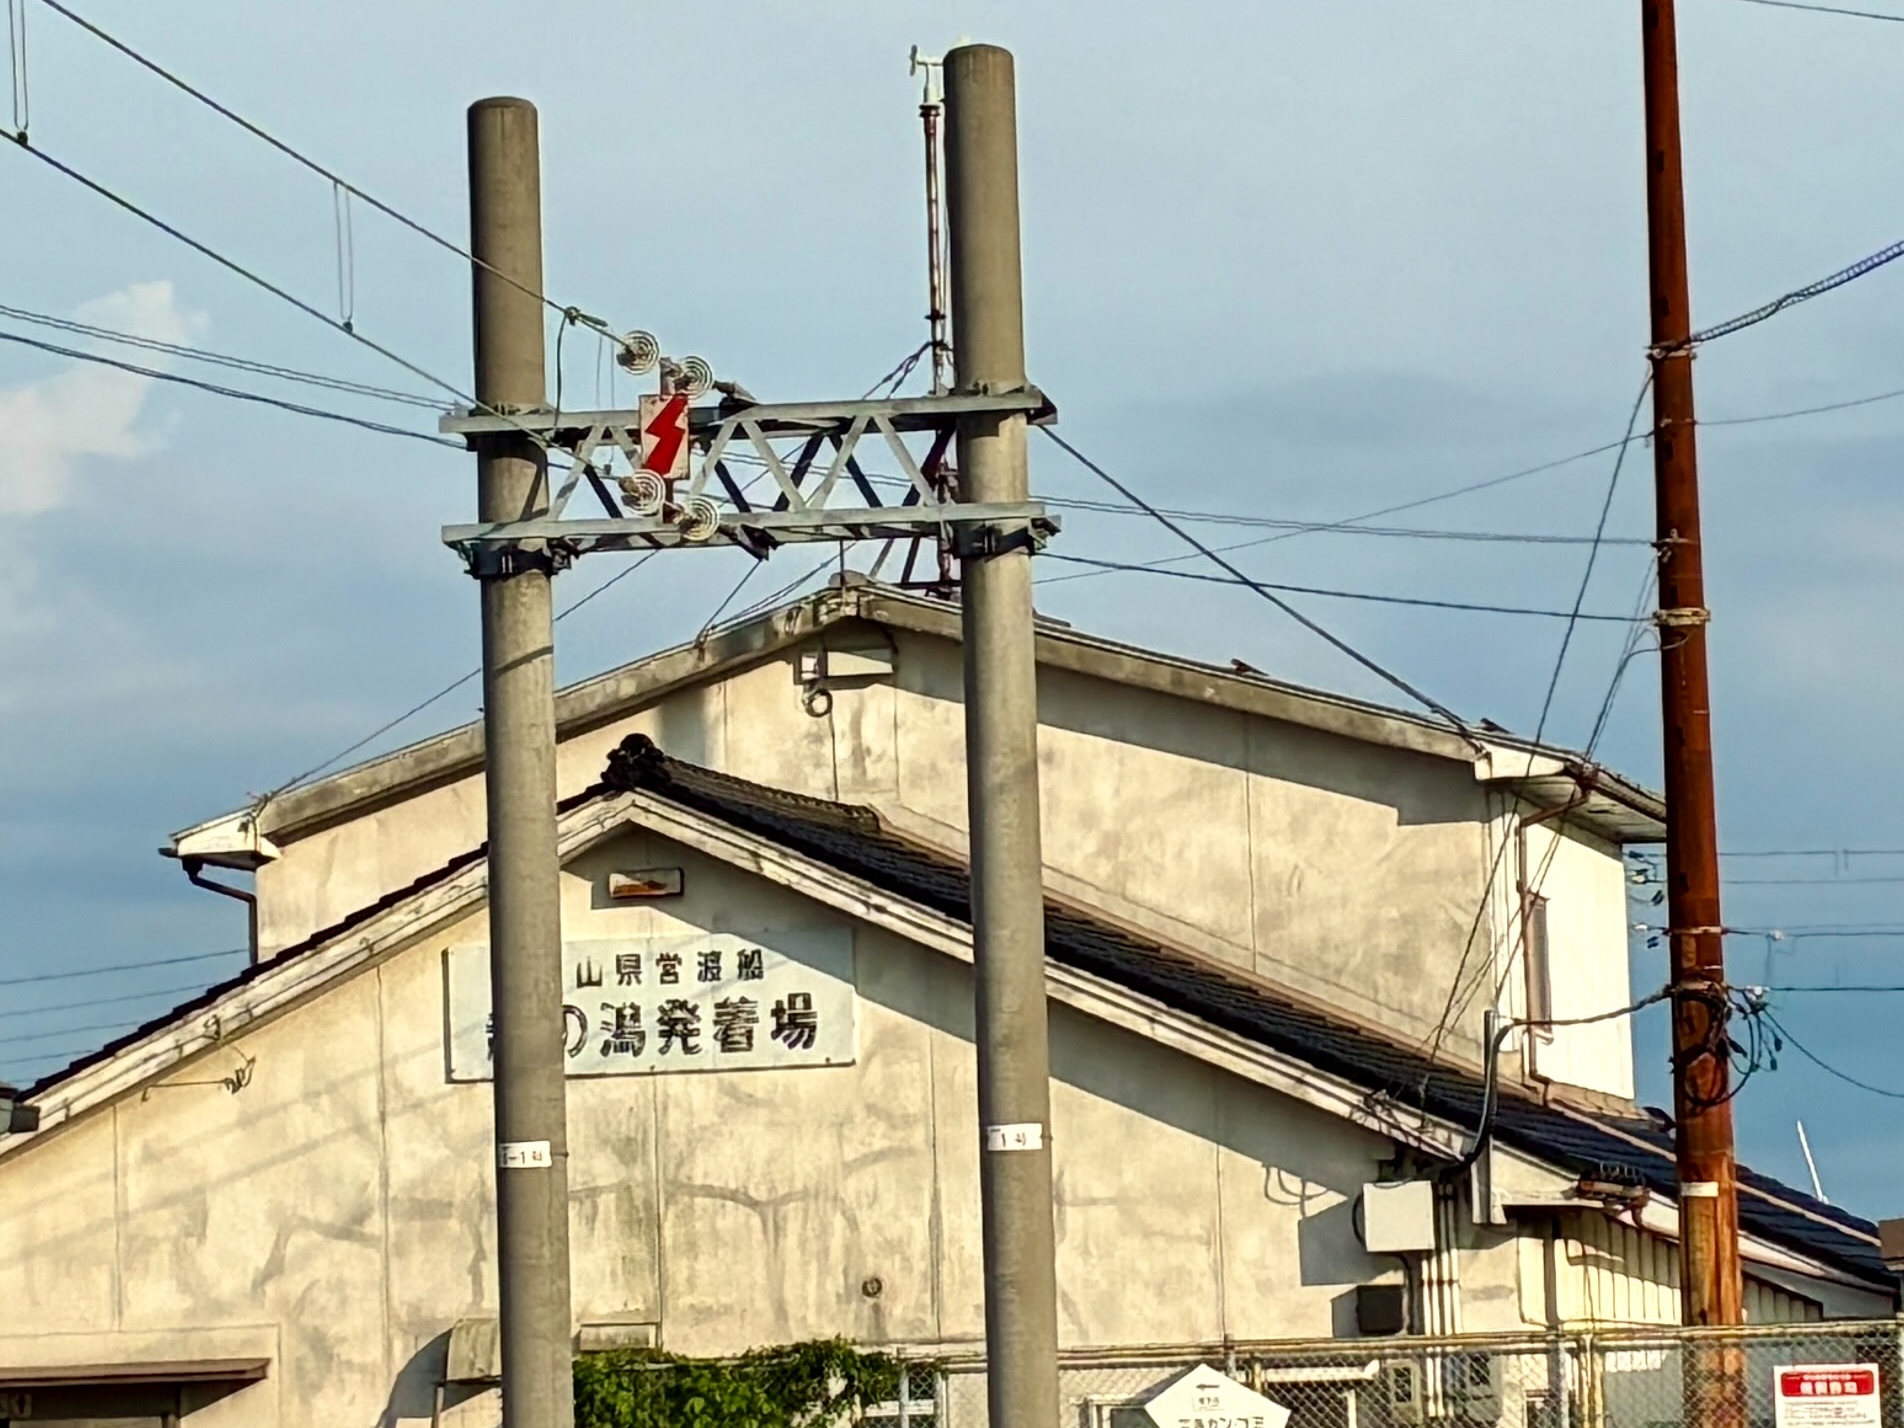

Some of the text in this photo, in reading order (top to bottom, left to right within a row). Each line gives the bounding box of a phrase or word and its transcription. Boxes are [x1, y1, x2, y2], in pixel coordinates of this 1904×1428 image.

[576, 948, 764, 989] 山県営渡船
[486, 991, 818, 1060] の潟発着場
